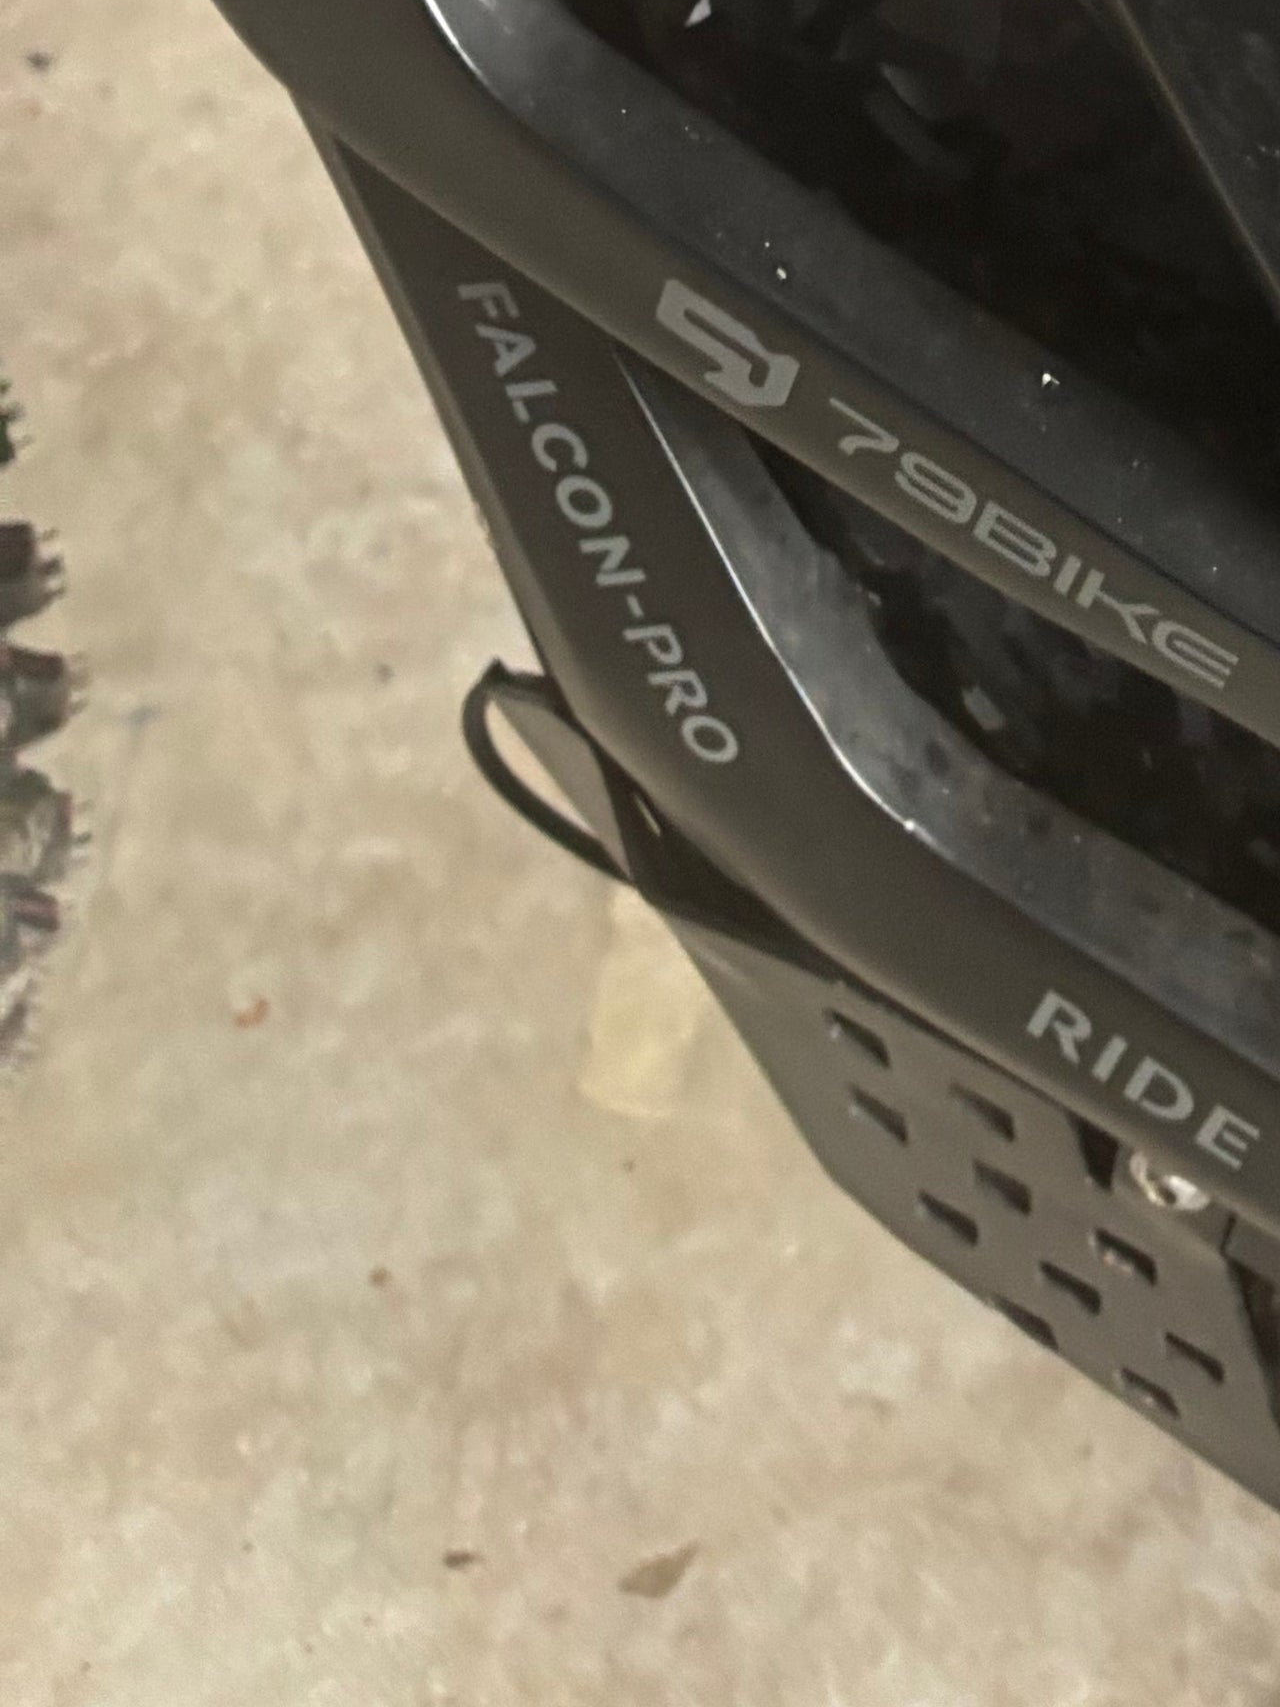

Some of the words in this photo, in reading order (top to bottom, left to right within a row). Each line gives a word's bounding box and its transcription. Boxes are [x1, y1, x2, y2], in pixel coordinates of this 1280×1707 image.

[456, 282, 739, 764] FALCON-PRO
[828, 396, 1240, 689] 79BIKE
[1025, 988, 1261, 1171] RIDE
